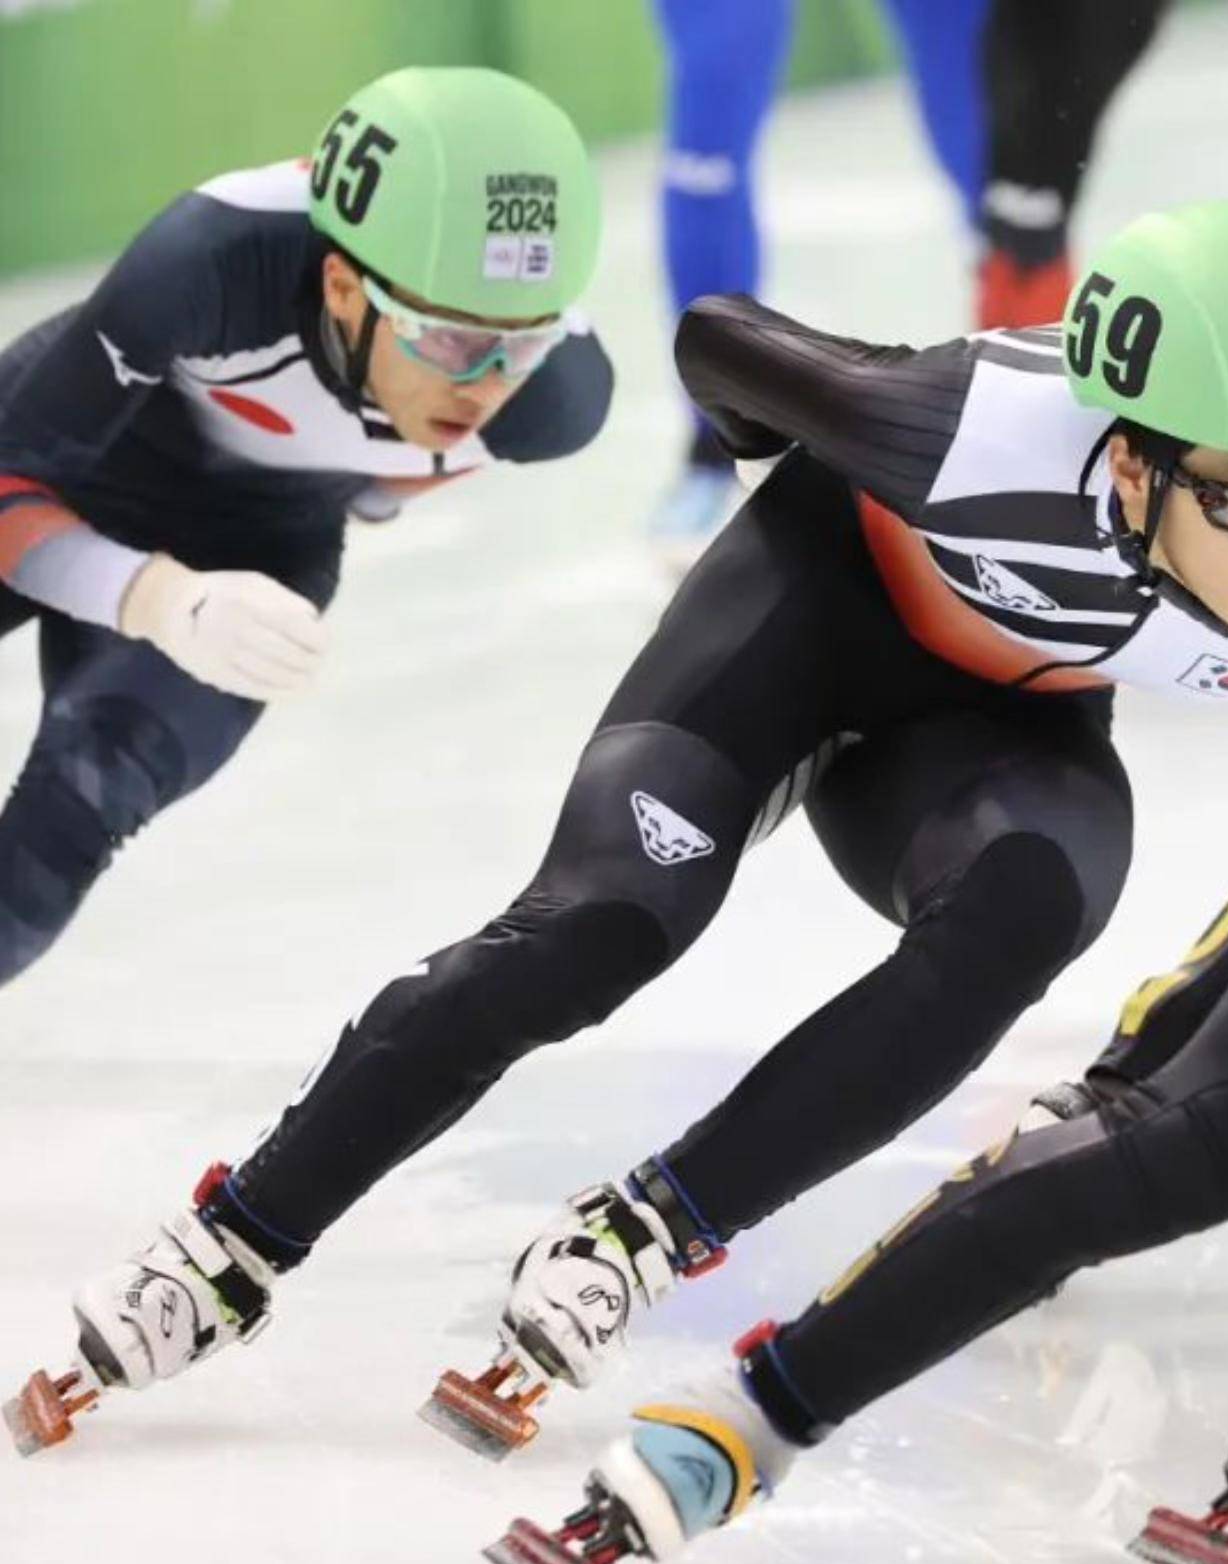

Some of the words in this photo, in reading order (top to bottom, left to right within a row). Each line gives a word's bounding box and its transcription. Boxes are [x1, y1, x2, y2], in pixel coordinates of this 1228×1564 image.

[311, 109, 398, 225] 55
[486, 198, 557, 233] 2024
[1066, 271, 1163, 399] 59
